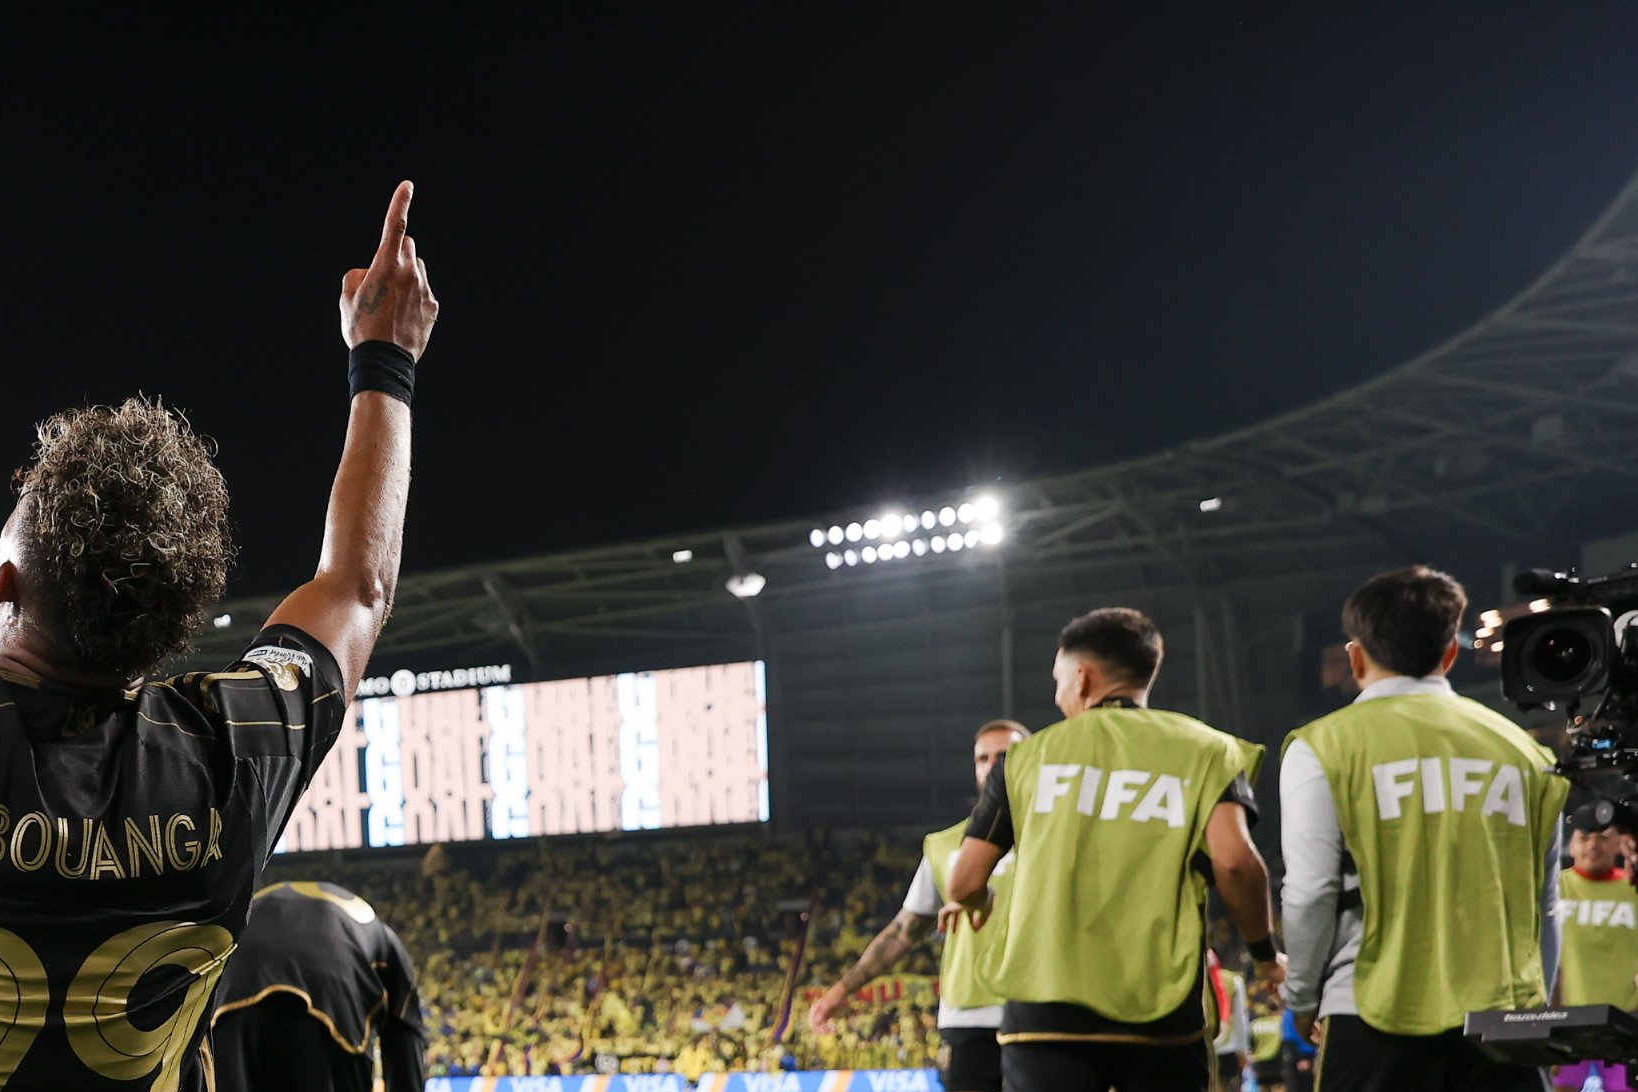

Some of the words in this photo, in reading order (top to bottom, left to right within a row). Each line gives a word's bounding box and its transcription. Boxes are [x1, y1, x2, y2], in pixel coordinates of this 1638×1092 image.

[355, 677, 390, 696] MO
[416, 664, 511, 691] STADIUM
[1033, 763, 1186, 828] FIFA
[1372, 757, 1527, 826] FIFA
